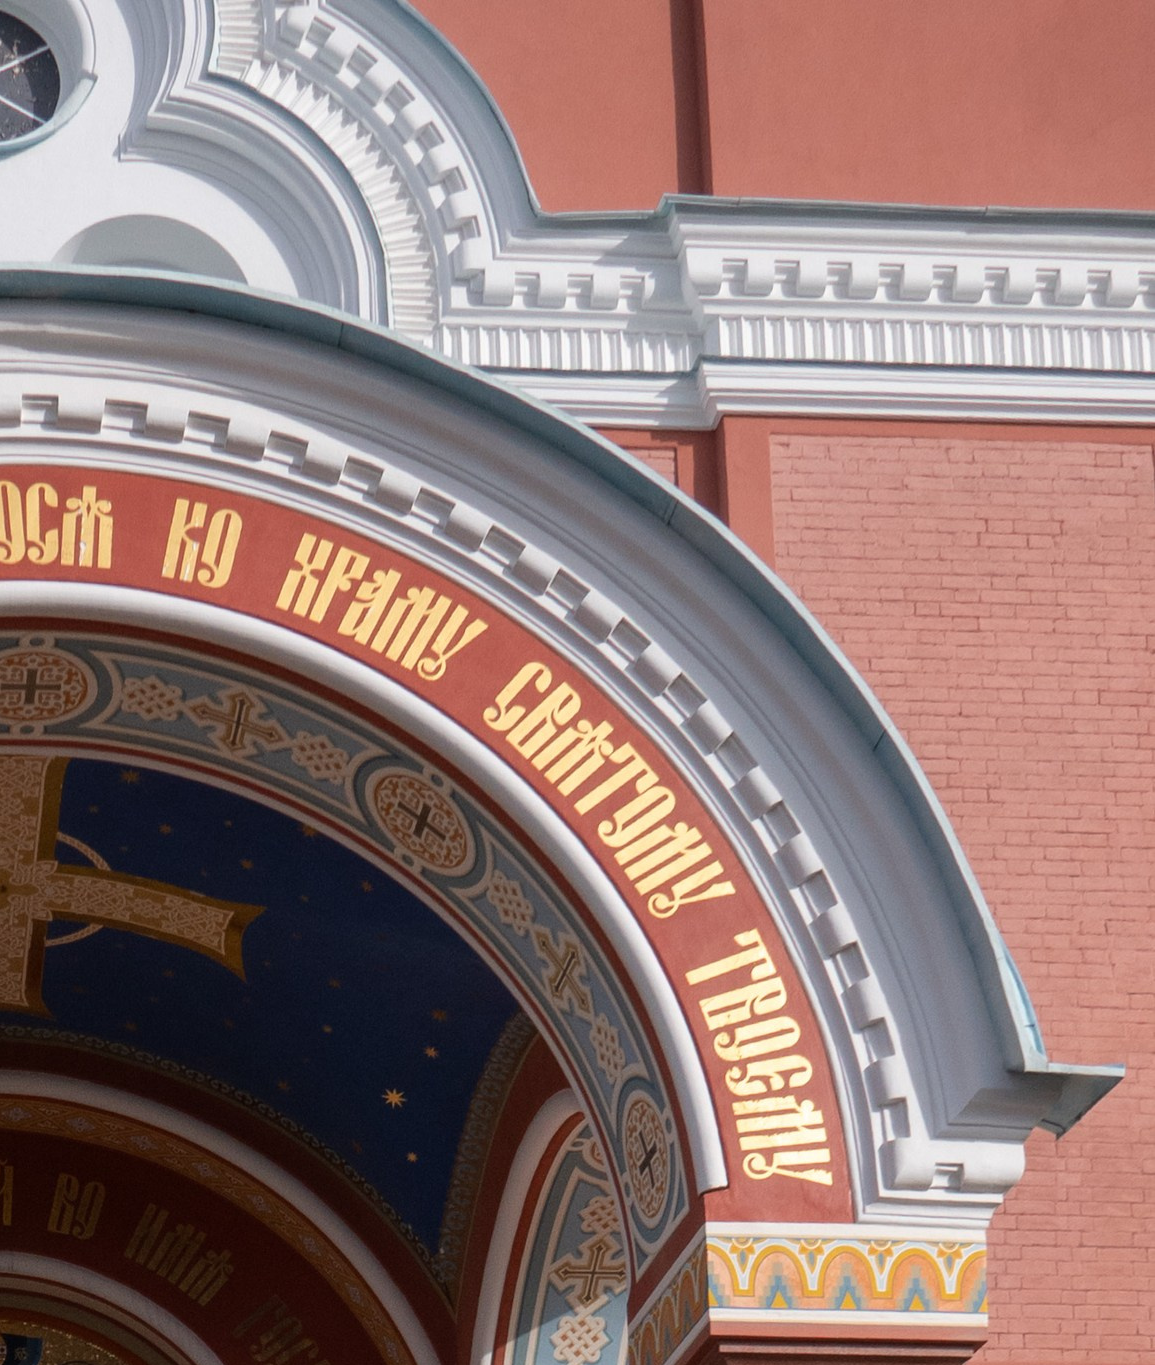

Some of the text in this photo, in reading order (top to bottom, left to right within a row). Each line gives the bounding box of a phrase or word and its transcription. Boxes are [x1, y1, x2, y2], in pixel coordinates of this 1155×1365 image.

[162, 498, 243, 589] КО
[276, 531, 487, 682] ХРАМУ
[685, 928, 834, 1186] ТВОЕМУ
[48, 1174, 106, 1240] ВО
